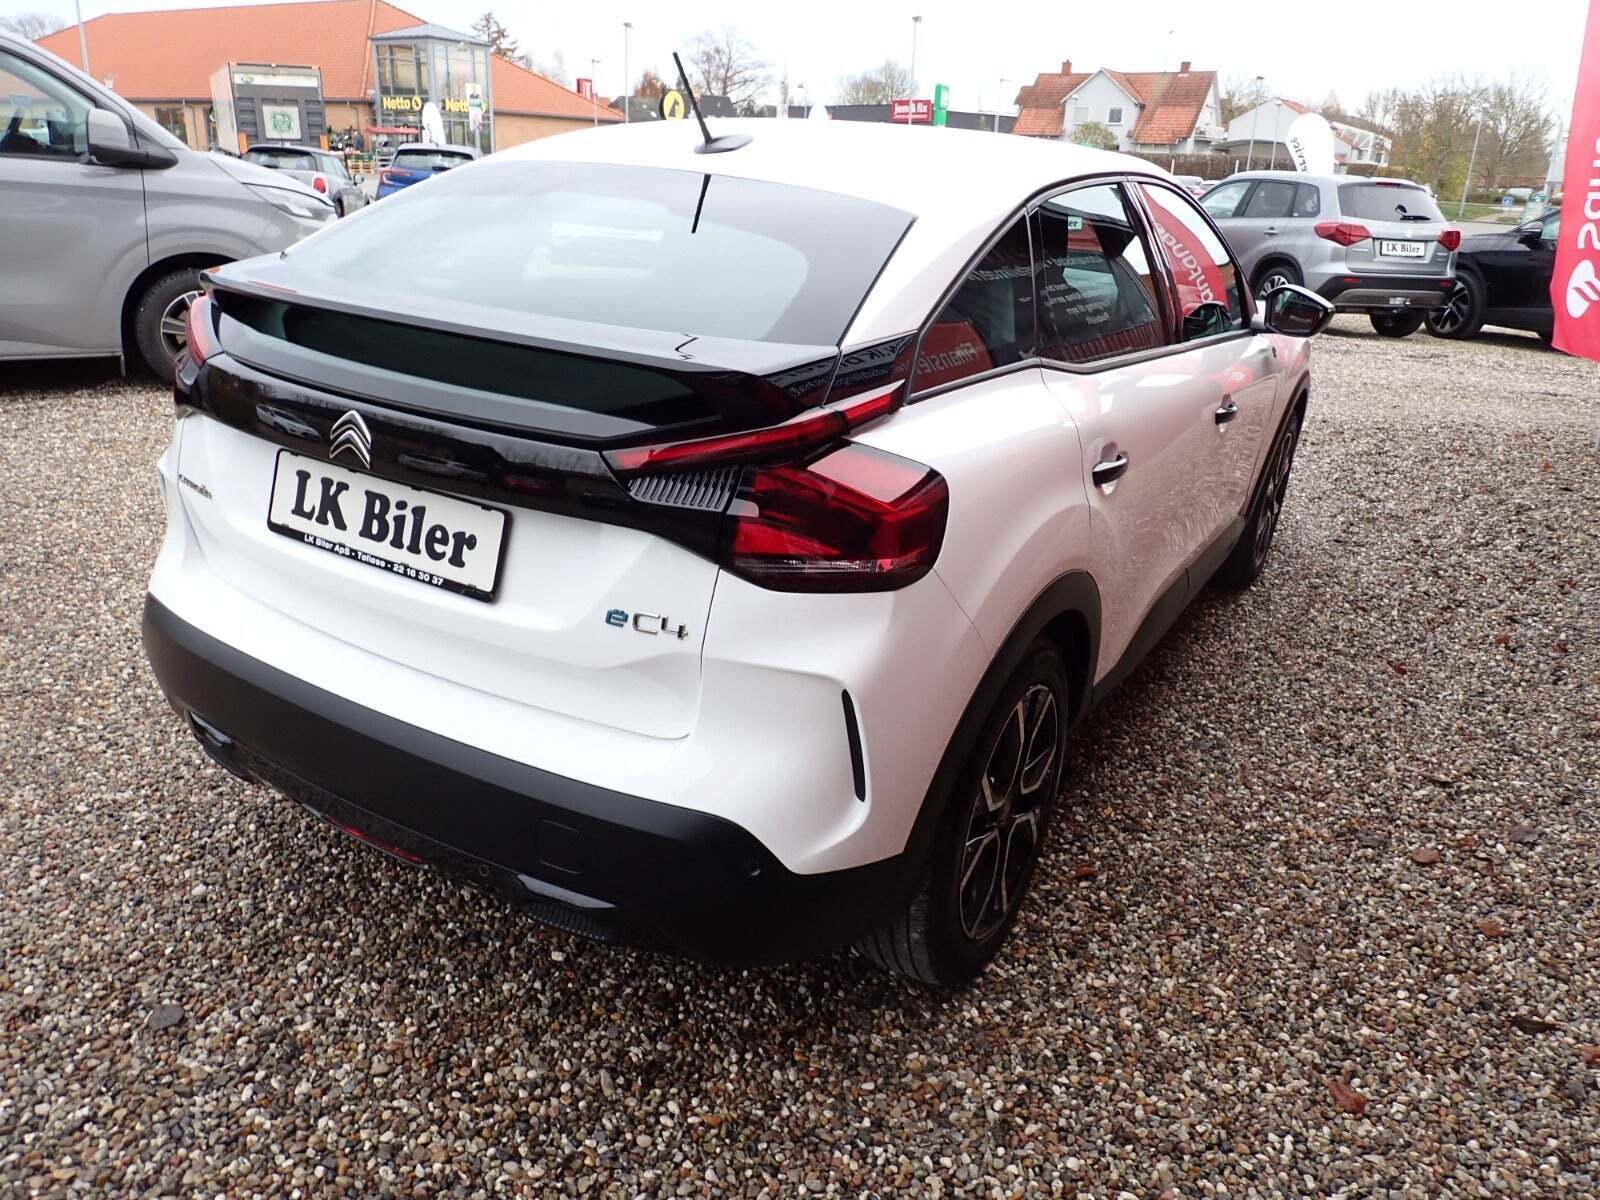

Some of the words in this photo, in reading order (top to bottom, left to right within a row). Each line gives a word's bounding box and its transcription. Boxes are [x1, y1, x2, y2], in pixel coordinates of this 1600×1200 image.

[383, 96, 410, 110] Netto
[445, 98, 470, 112] Nett
[917, 102, 928, 113] fix
[1386, 243, 1398, 252] LK
[1400, 243, 1421, 253] Biler
[291, 469, 350, 531] LK
[358, 489, 478, 569] Biler
[304, 533, 315, 544] LK
[316, 538, 334, 550] Biler
[334, 543, 351, 556] ApS
[393, 563, 405, 574] 22
[406, 567, 417, 578] 16
[418, 571, 430, 582] 30
[431, 575, 444, 586] 37
